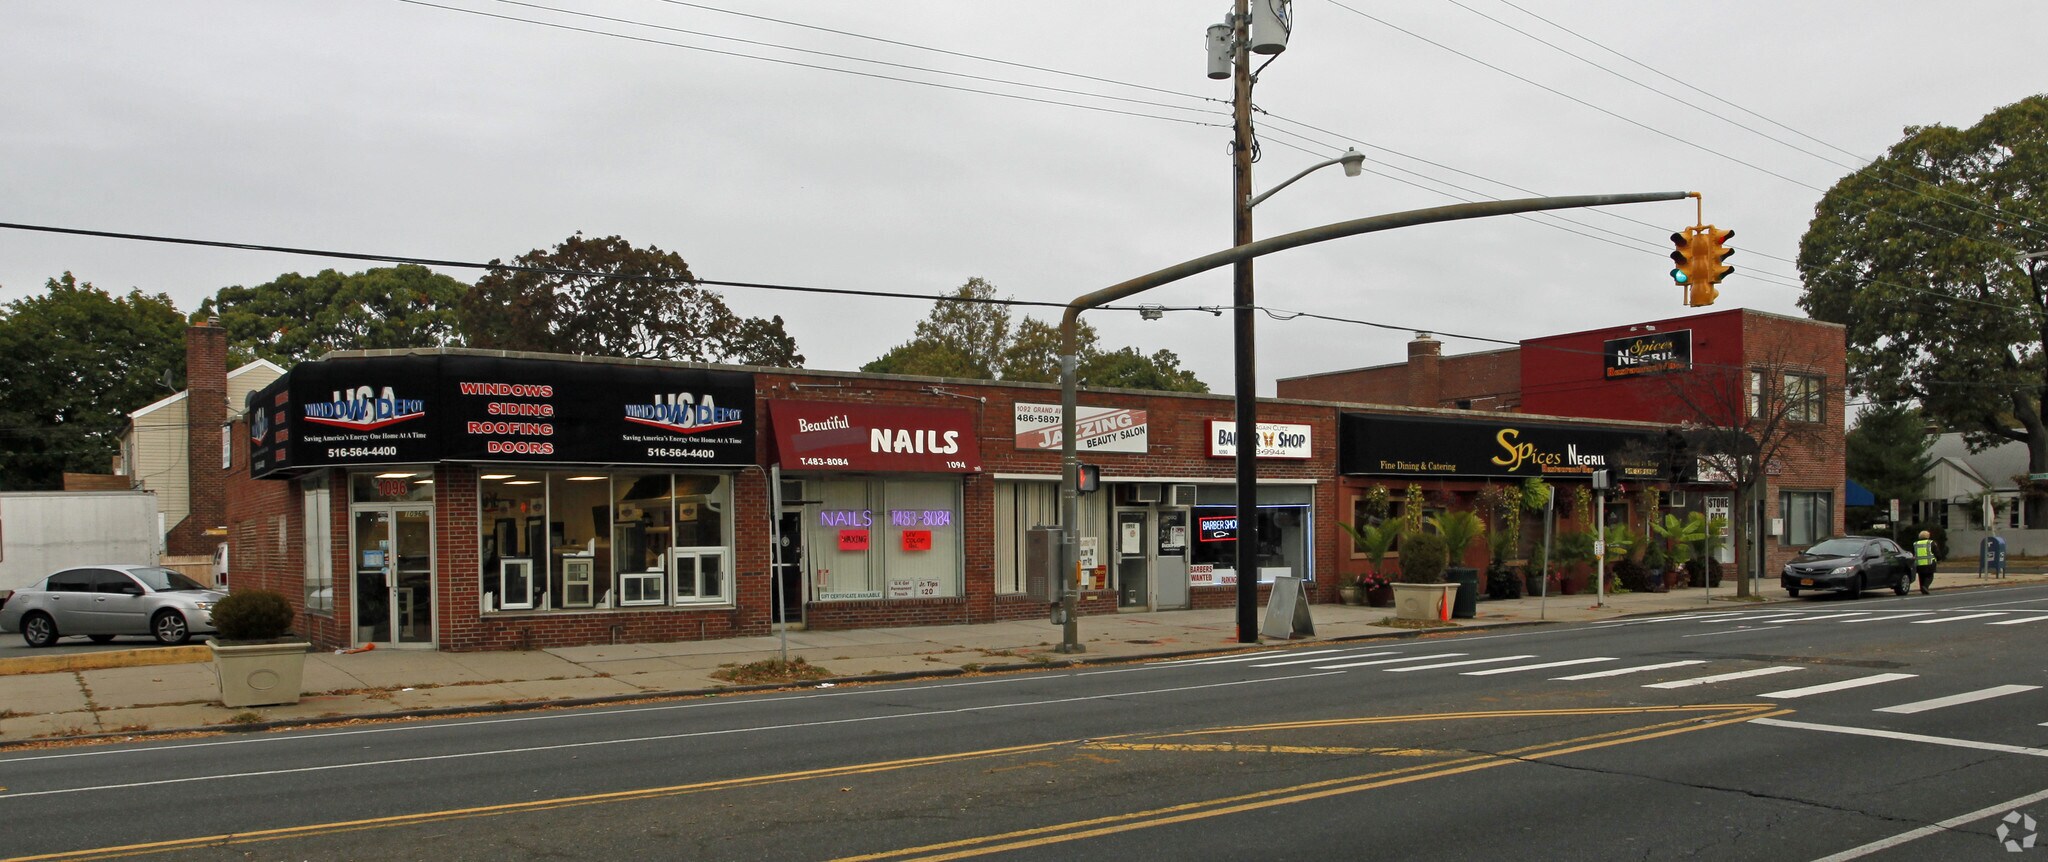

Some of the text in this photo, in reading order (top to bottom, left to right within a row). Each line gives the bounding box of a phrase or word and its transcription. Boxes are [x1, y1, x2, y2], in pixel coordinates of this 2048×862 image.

[1630, 339, 1673, 355] Spices
[460, 382, 553, 397] WINDOWS
[304, 399, 370, 420] WINDOW
[374, 398, 425, 419] DEPOT
[333, 385, 396, 424] USA
[488, 402, 553, 417] SIDING
[654, 392, 715, 429] USA
[625, 404, 742, 424] WINDOW DEPOT
[1017, 414, 1060, 423] 486-5897
[468, 421, 553, 436] ROOFING
[798, 415, 850, 432] Beautiful
[304, 435, 322, 443] Saving
[622, 434, 641, 442] Saving
[870, 428, 959, 454] NAILS
[1086, 426, 1145, 448] BEAUTY SALON
[1278, 431, 1306, 448] SHOP
[328, 446, 397, 458] 516-564-4400
[488, 440, 554, 455] DOORS
[647, 448, 715, 458] 516-564-4400
[1491, 428, 1606, 472] Spices NEGRIL
[800, 457, 849, 466] T.483-8084
[946, 461, 966, 469] 1094
[1380, 460, 1456, 472] Fine Dining & Catering
[378, 480, 407, 496] 1096
[1708, 497, 1728, 508] STORE
[821, 510, 873, 527] NAILS
[1202, 519, 1238, 530] BARBER SHO
[842, 535, 867, 543] WAXING
[1190, 565, 1213, 573] BARBERS
